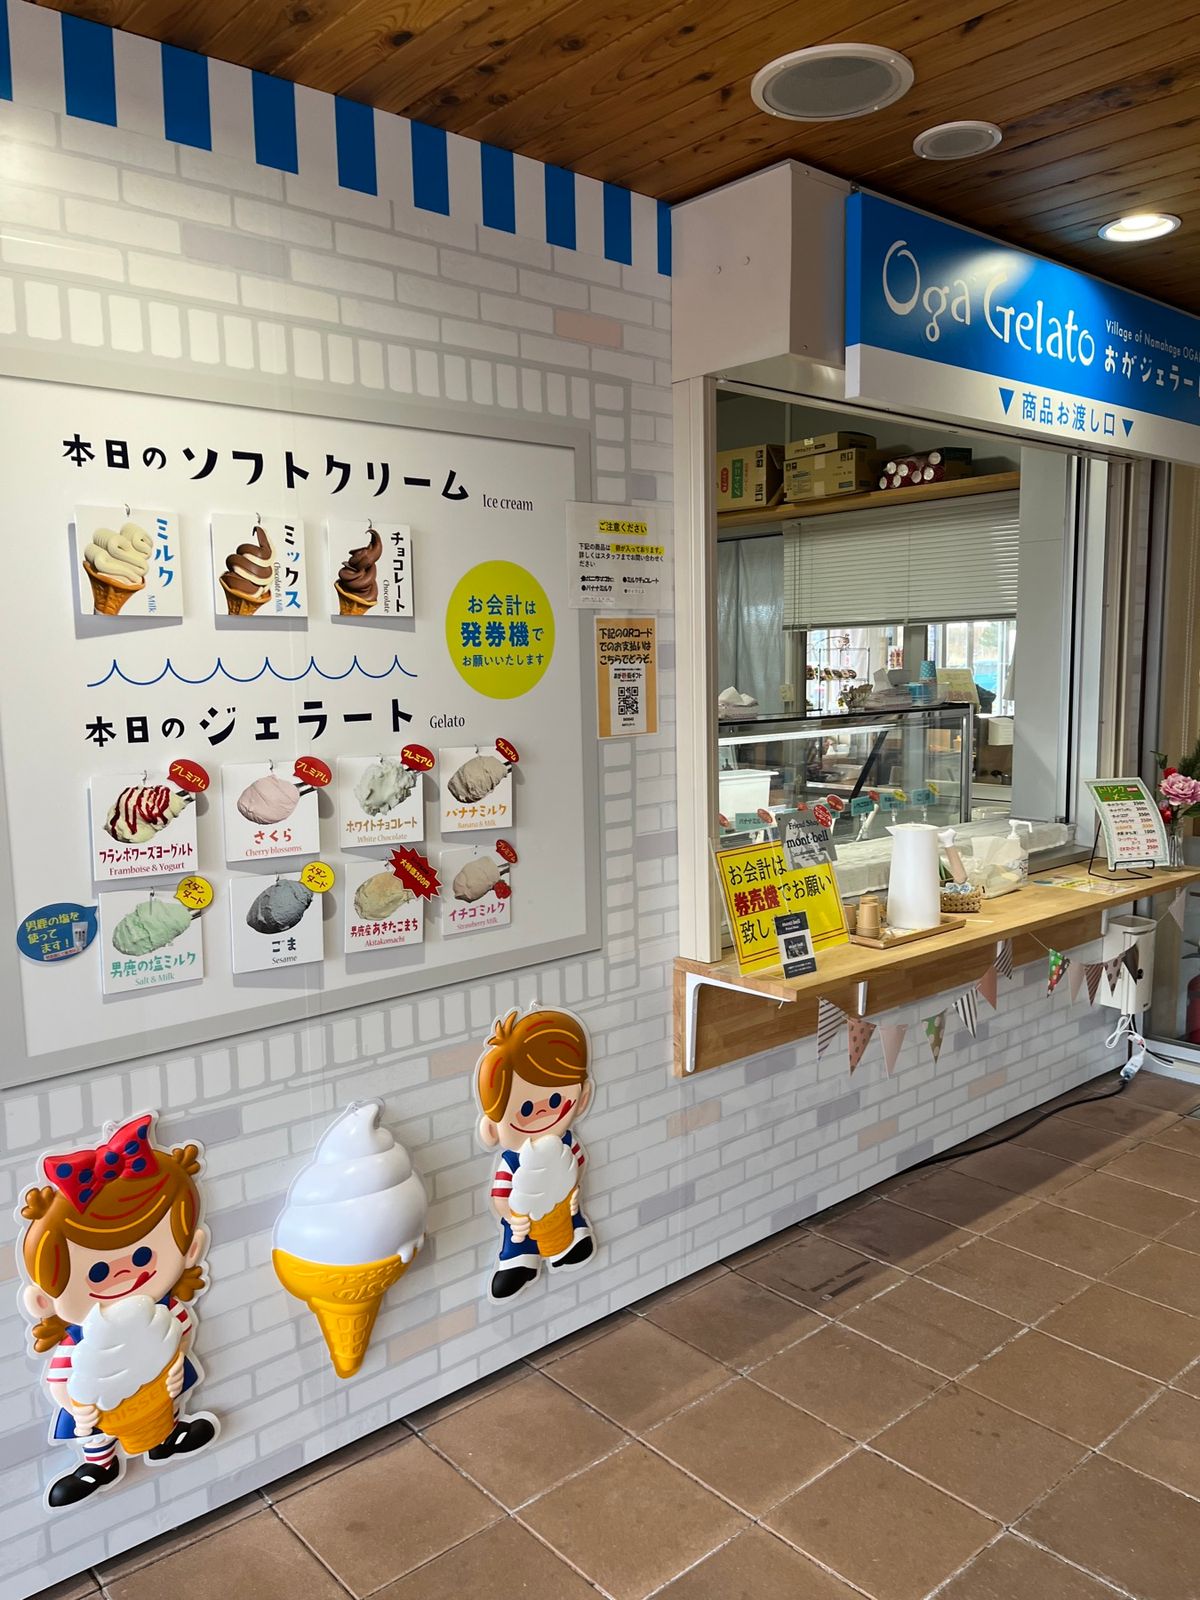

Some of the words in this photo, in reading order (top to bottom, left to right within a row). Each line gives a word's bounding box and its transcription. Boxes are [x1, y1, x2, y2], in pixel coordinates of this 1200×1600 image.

[883, 240, 972, 342] Oga
[984, 272, 1096, 366] Gelato
[1106, 319, 1133, 342] Village
[1135, 329, 1143, 343] of
[1145, 333, 1181, 358] Namahage
[1022, 392, 1115, 437] 商品お渡し口
[62, 434, 469, 500] 本日のソフトクリーム
[483, 494, 498, 508] Ice
[500, 496, 533, 511] cream
[599, 522, 647, 533] ご注意ください
[154, 518, 174, 587] ミルク
[284, 525, 301, 609] ミックス
[391, 532, 405, 612] チョコレート
[148, 595, 157, 613] Milk
[383, 580, 391, 613] Chocolate
[468, 594, 536, 616] お会計は
[461, 621, 544, 647] 発券機で
[599, 628, 653, 640] 下記のQRコード
[599, 642, 651, 652] でのお支払いは
[462, 654, 544, 667] お願いいたします
[86, 699, 413, 748] 本日のジェラート
[429, 715, 465, 729] Gelato
[403, 749, 433, 767] プレミアム
[171, 763, 206, 790] プレミアム
[296, 761, 329, 783] プレミアム
[446, 804, 507, 818] バナナミルク
[345, 816, 417, 832] ホワイトチョコレート
[254, 828, 292, 844] さくら
[99, 842, 193, 864] フランボワーズヨーグルト
[245, 848, 269, 857] Cherry
[270, 846, 302, 855] blossoms
[109, 864, 150, 876] Framboise
[159, 862, 185, 872] Yogurt
[307, 865, 328, 879] スタン
[728, 855, 787, 886] お会計は
[184, 879, 205, 894] スタン
[306, 874, 328, 889] ダード
[183, 889, 206, 905] ダード
[734, 875, 832, 917] 券売機でお願い
[449, 902, 505, 921] イチゴミルク
[25, 911, 80, 932] 男鹿の塩を
[350, 918, 418, 937] 男鹿産あきたこまち
[27, 928, 58, 944] 使って
[271, 937, 297, 952] ごま
[110, 952, 196, 978] 男鹿の塩ミルク
[272, 955, 298, 965] Sesame
